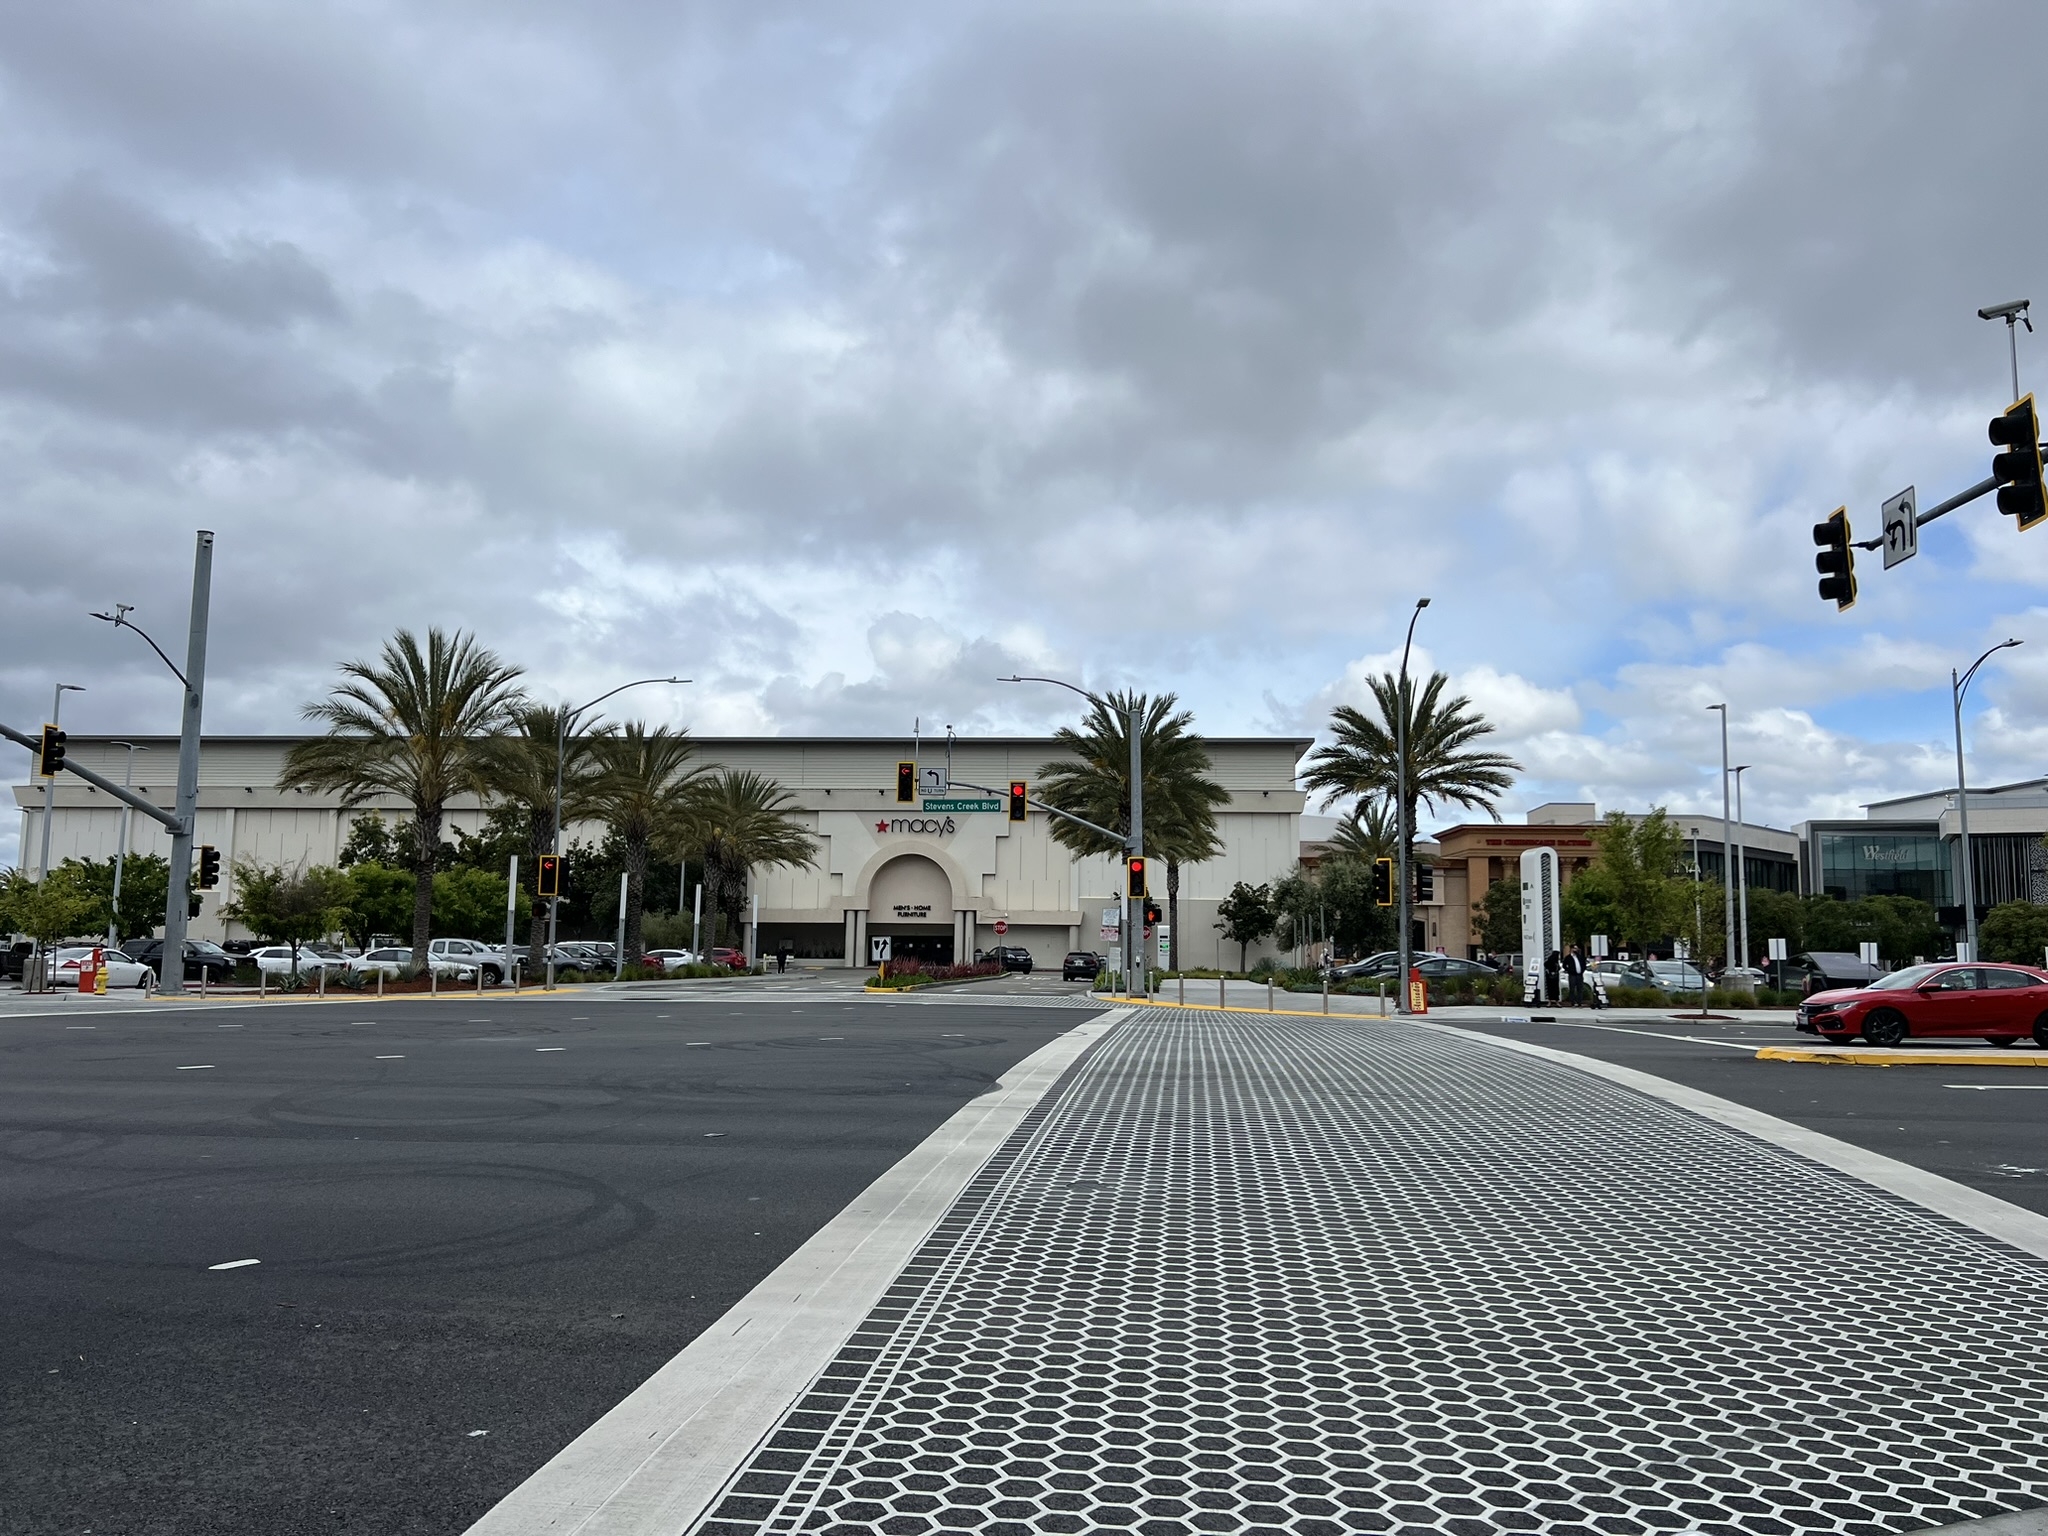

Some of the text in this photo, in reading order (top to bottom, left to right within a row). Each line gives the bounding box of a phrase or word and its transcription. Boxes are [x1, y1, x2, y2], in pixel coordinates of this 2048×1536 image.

[925, 802, 999, 810] Stevens Creek Blvd
[891, 816, 955, 837] macy's
[1862, 845, 1910, 861] Westfield
